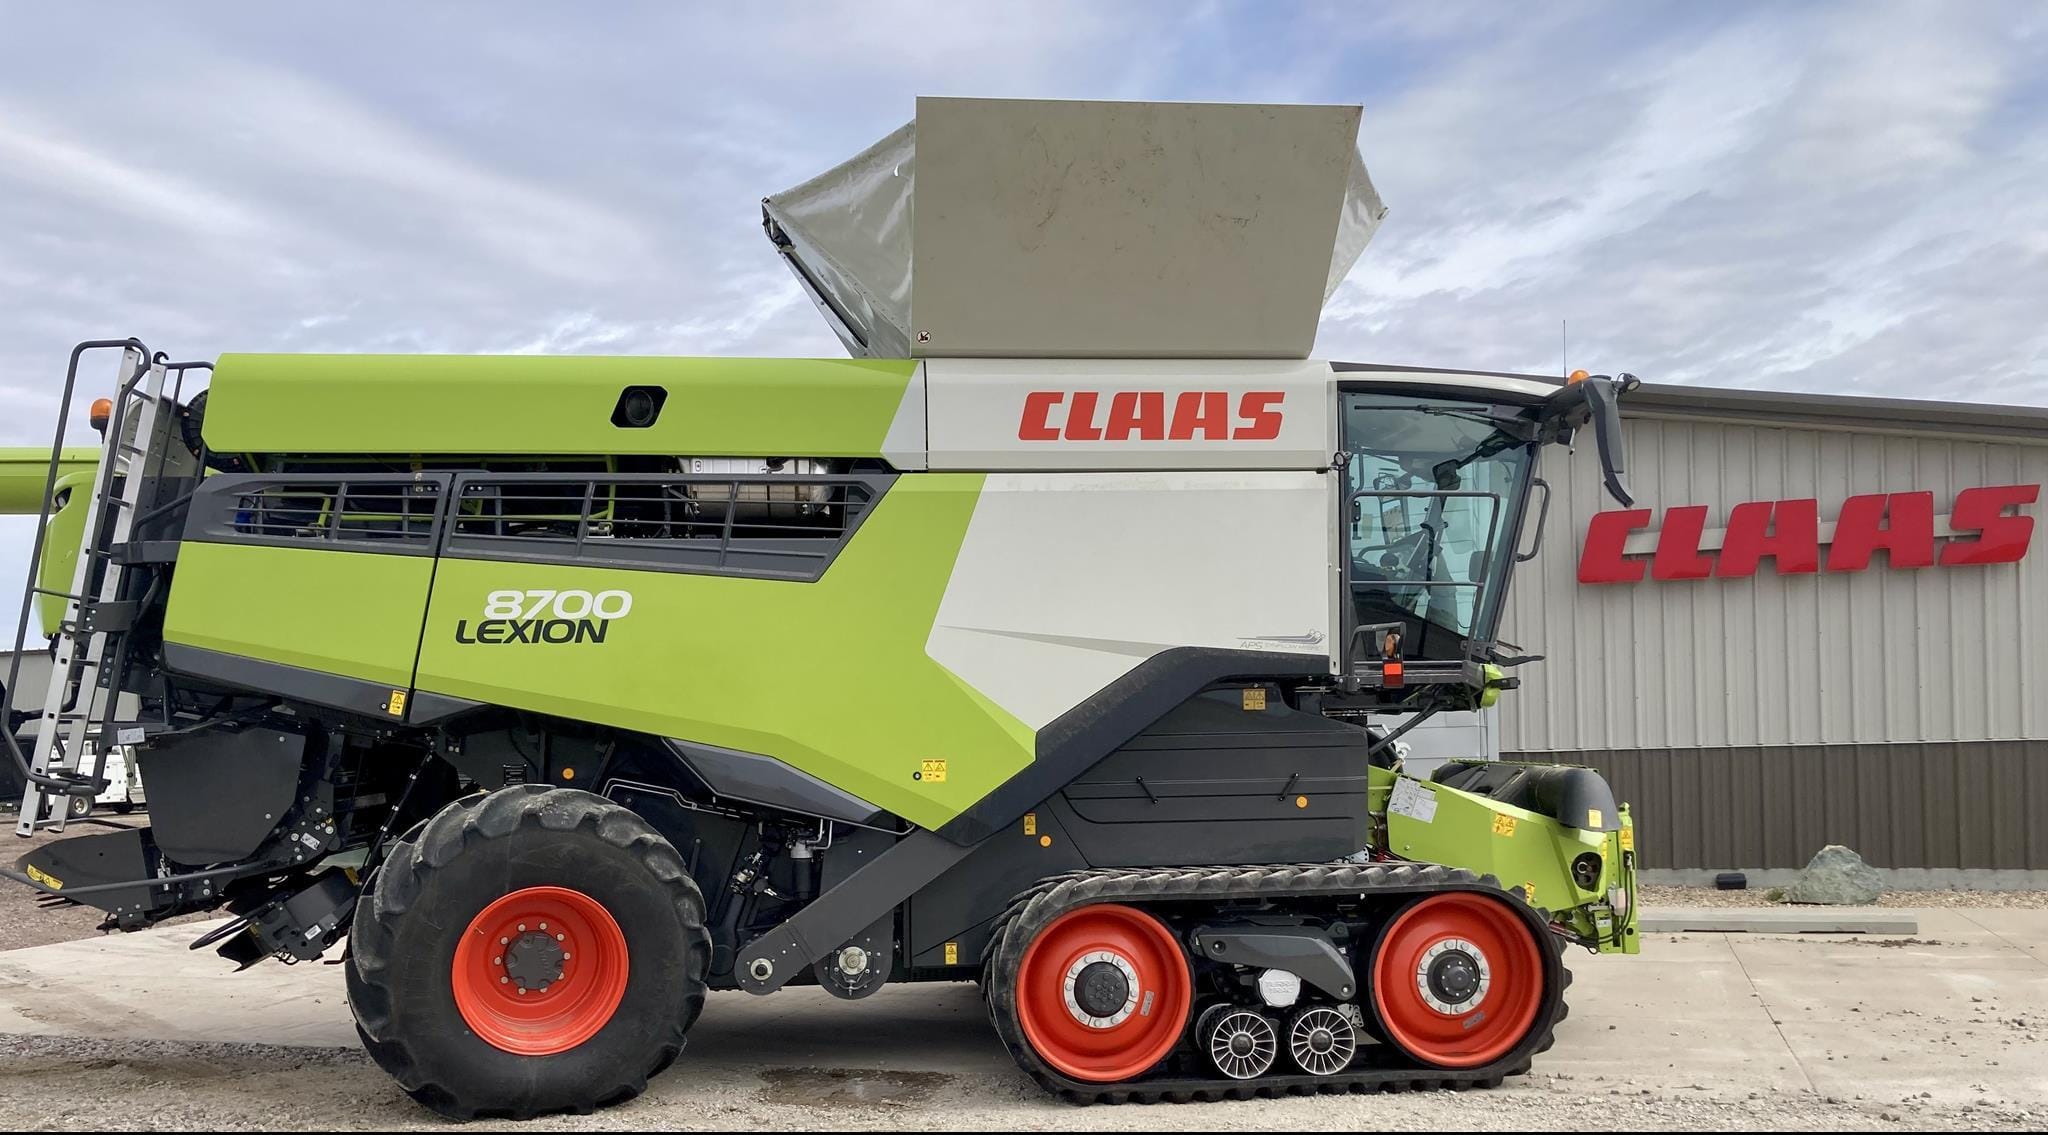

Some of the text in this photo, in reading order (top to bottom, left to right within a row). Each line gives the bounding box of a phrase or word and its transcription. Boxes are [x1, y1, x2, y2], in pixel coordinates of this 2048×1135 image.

[1018, 391, 1285, 441] CLAAS
[1578, 484, 2040, 584] CLAAS
[483, 589, 633, 620] 8700
[455, 619, 609, 644] LEXION
